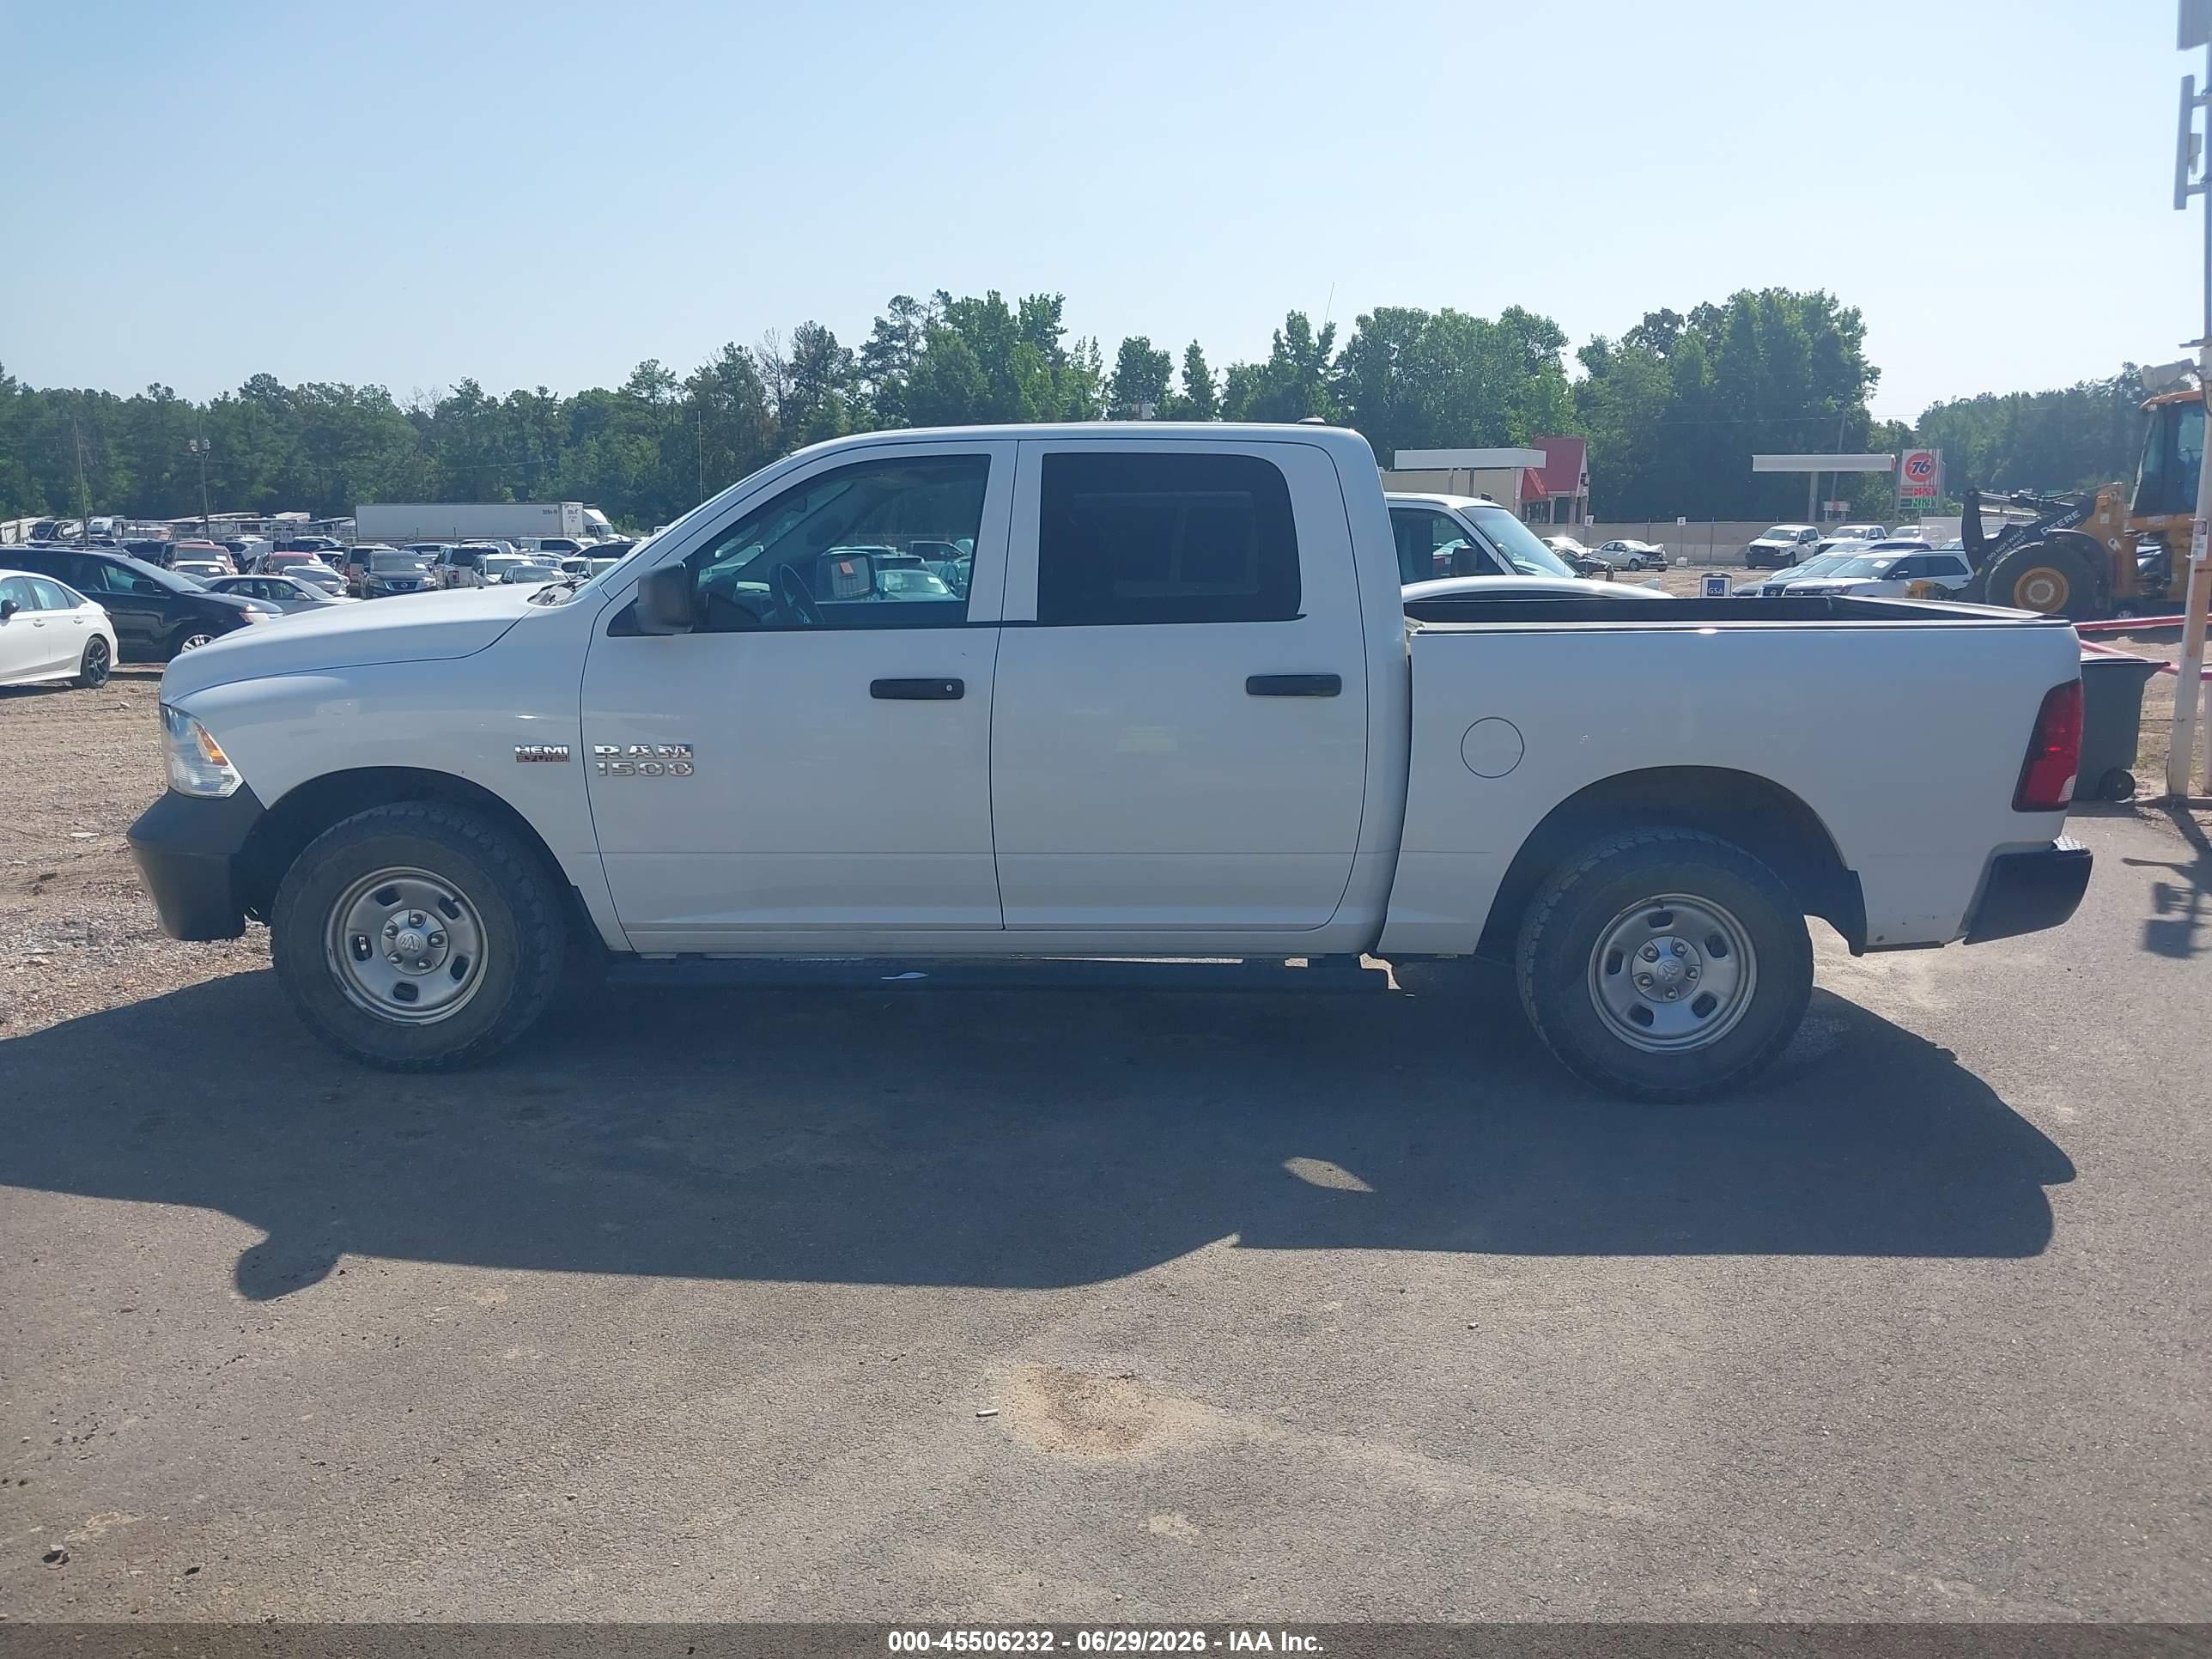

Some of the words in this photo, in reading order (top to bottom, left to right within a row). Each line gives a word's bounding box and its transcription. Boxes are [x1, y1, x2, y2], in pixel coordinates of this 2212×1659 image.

[1910, 459, 1931, 476] 76
[2040, 510, 2081, 536] DEERE
[1986, 552, 1996, 561] DO
[1995, 542, 2008, 554] NOT
[515, 744, 568, 756] HEMI
[593, 744, 693, 759] RAM
[596, 761, 694, 776] 1500
